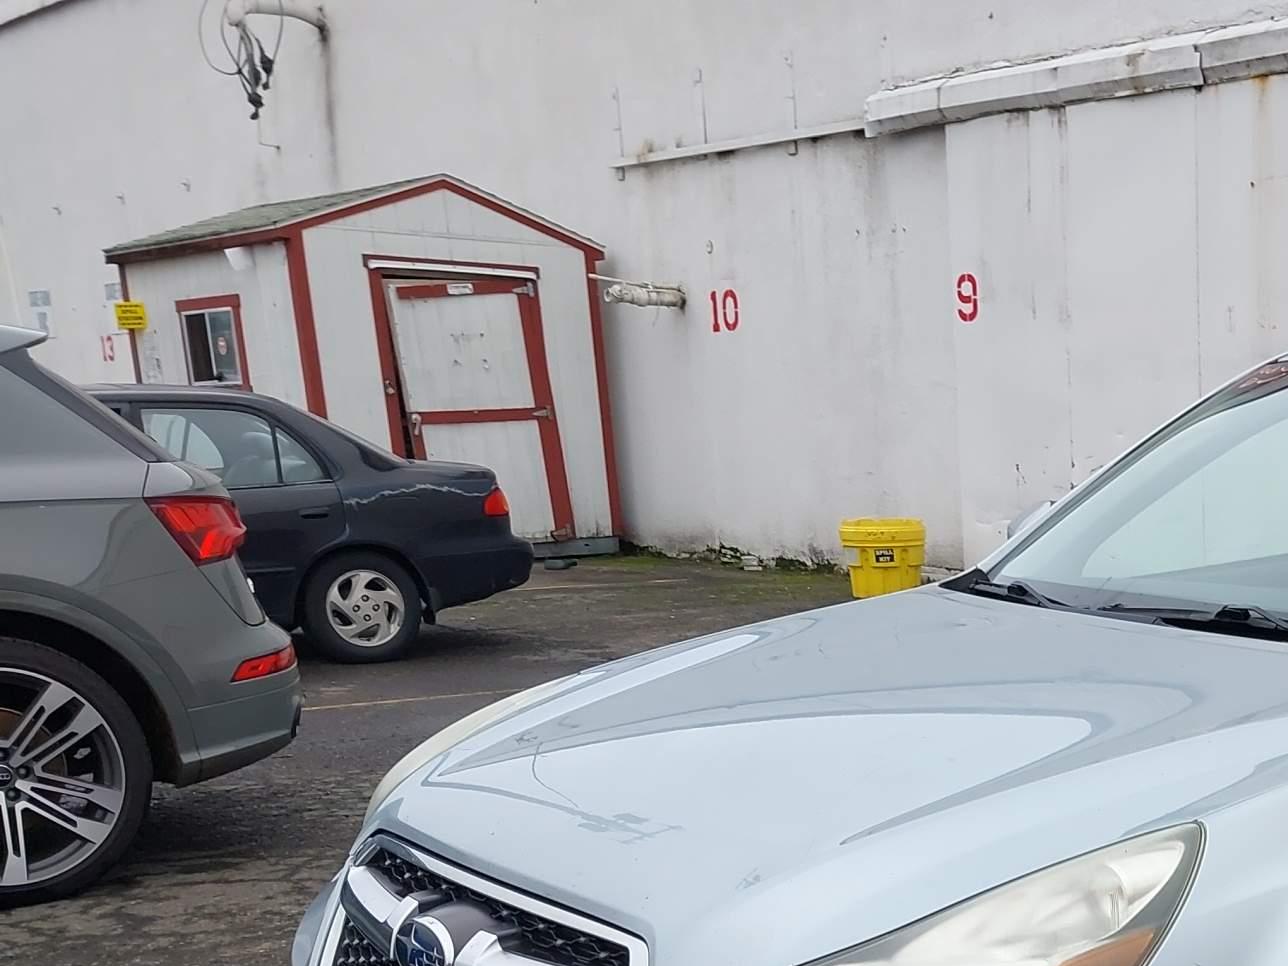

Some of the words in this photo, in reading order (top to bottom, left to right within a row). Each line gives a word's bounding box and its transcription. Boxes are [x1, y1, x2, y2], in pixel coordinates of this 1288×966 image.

[710, 289, 739, 332] 10
[957, 273, 978, 322] 9
[100, 335, 114, 362] 13
